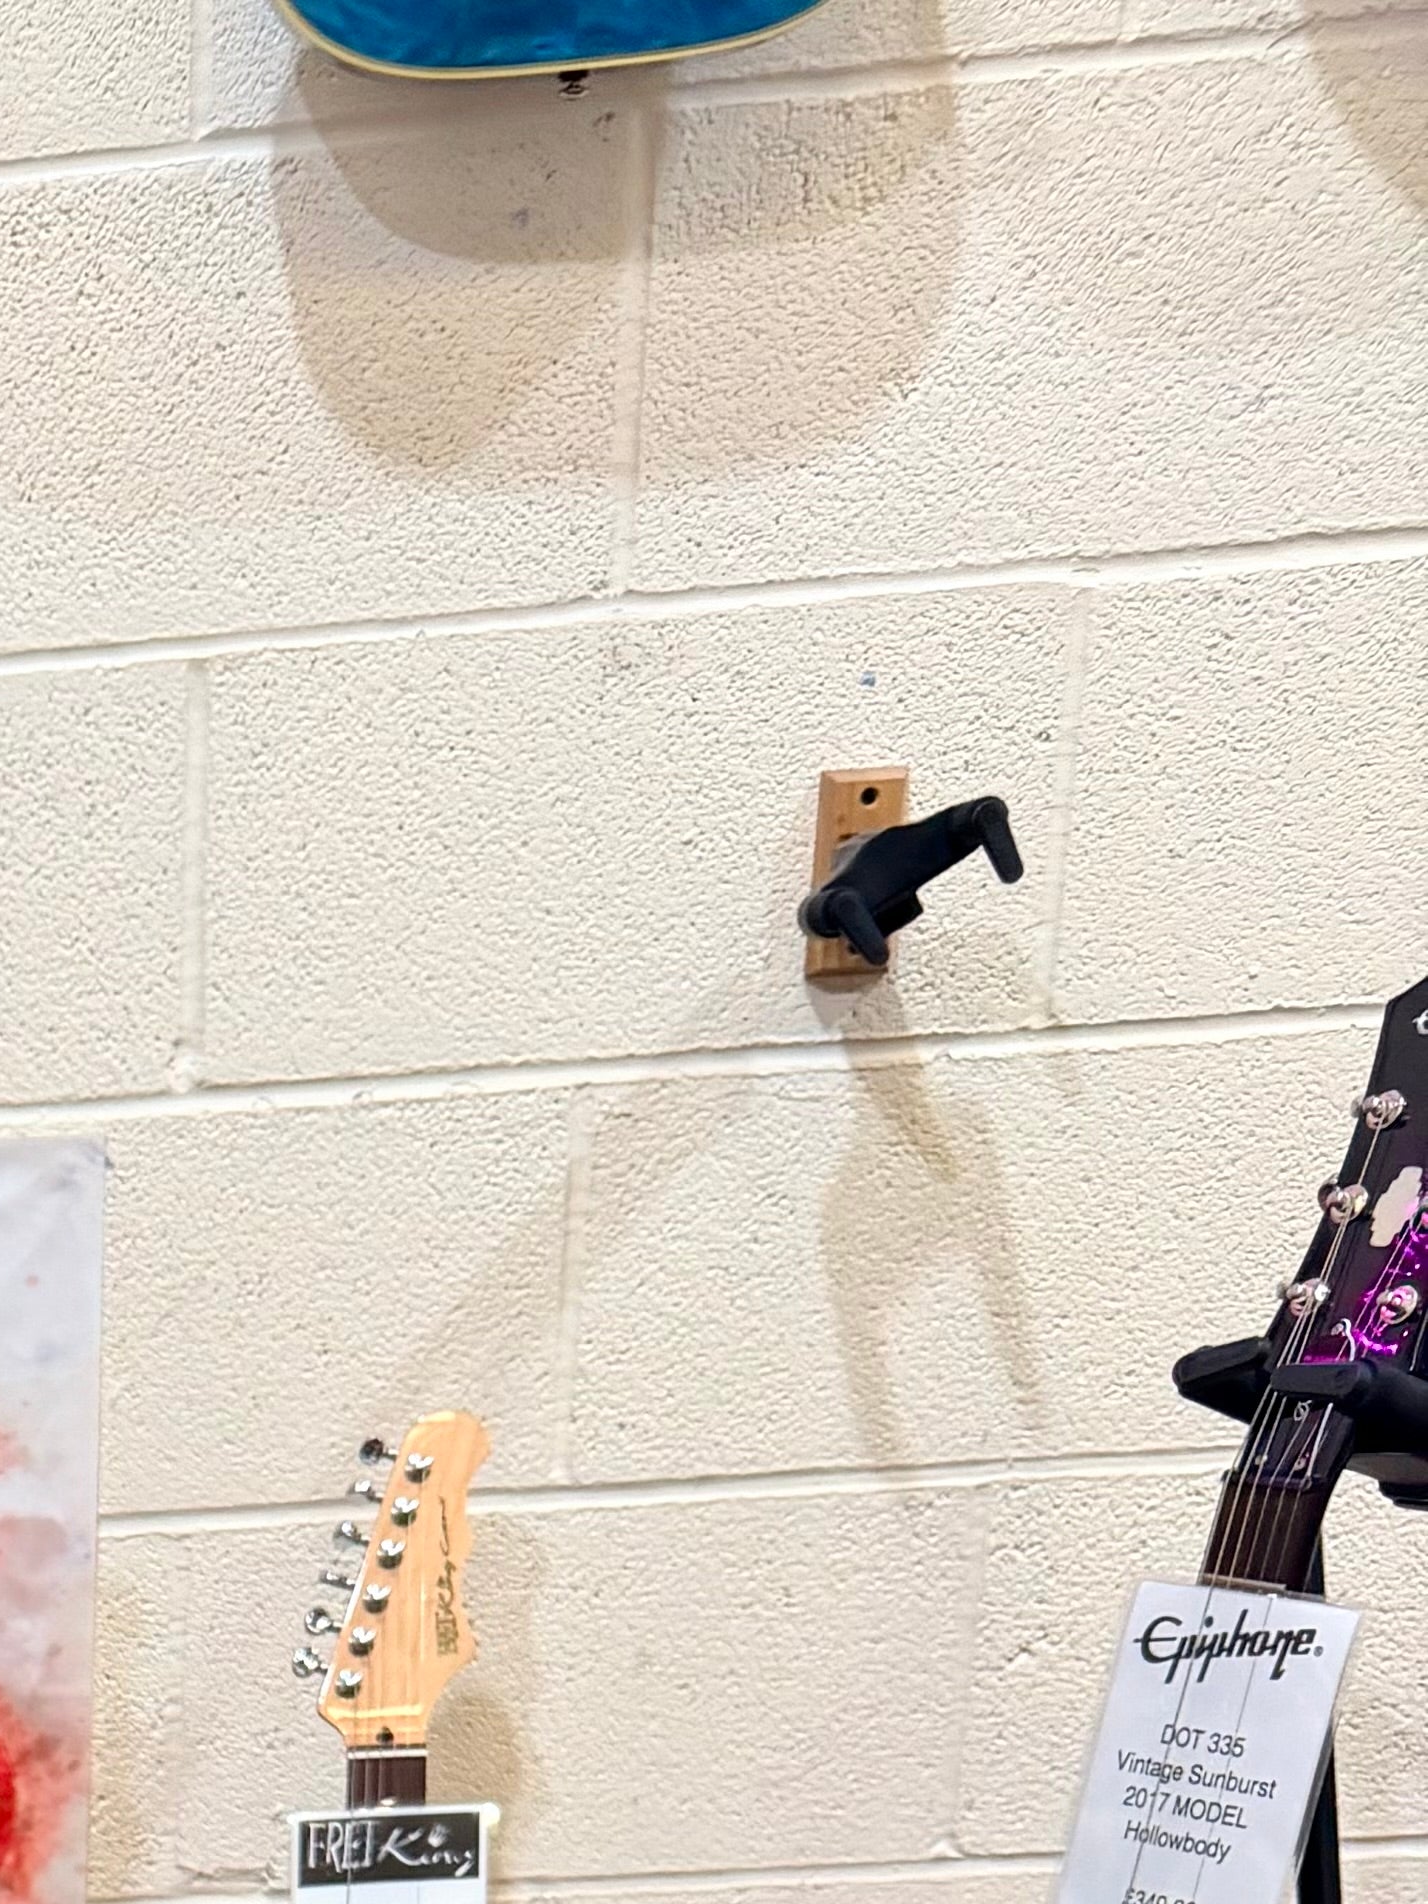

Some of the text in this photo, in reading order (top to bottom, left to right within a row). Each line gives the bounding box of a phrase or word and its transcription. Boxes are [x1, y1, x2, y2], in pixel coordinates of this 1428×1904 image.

[1133, 1609, 1318, 1684] Epiphone
[1160, 1724, 1246, 1758] DOT 335
[1117, 1750, 1278, 1800] Vintage Sunburst
[1123, 1786, 1249, 1829] 2017 MODEL
[1124, 1821, 1232, 1865] Hollowbody
